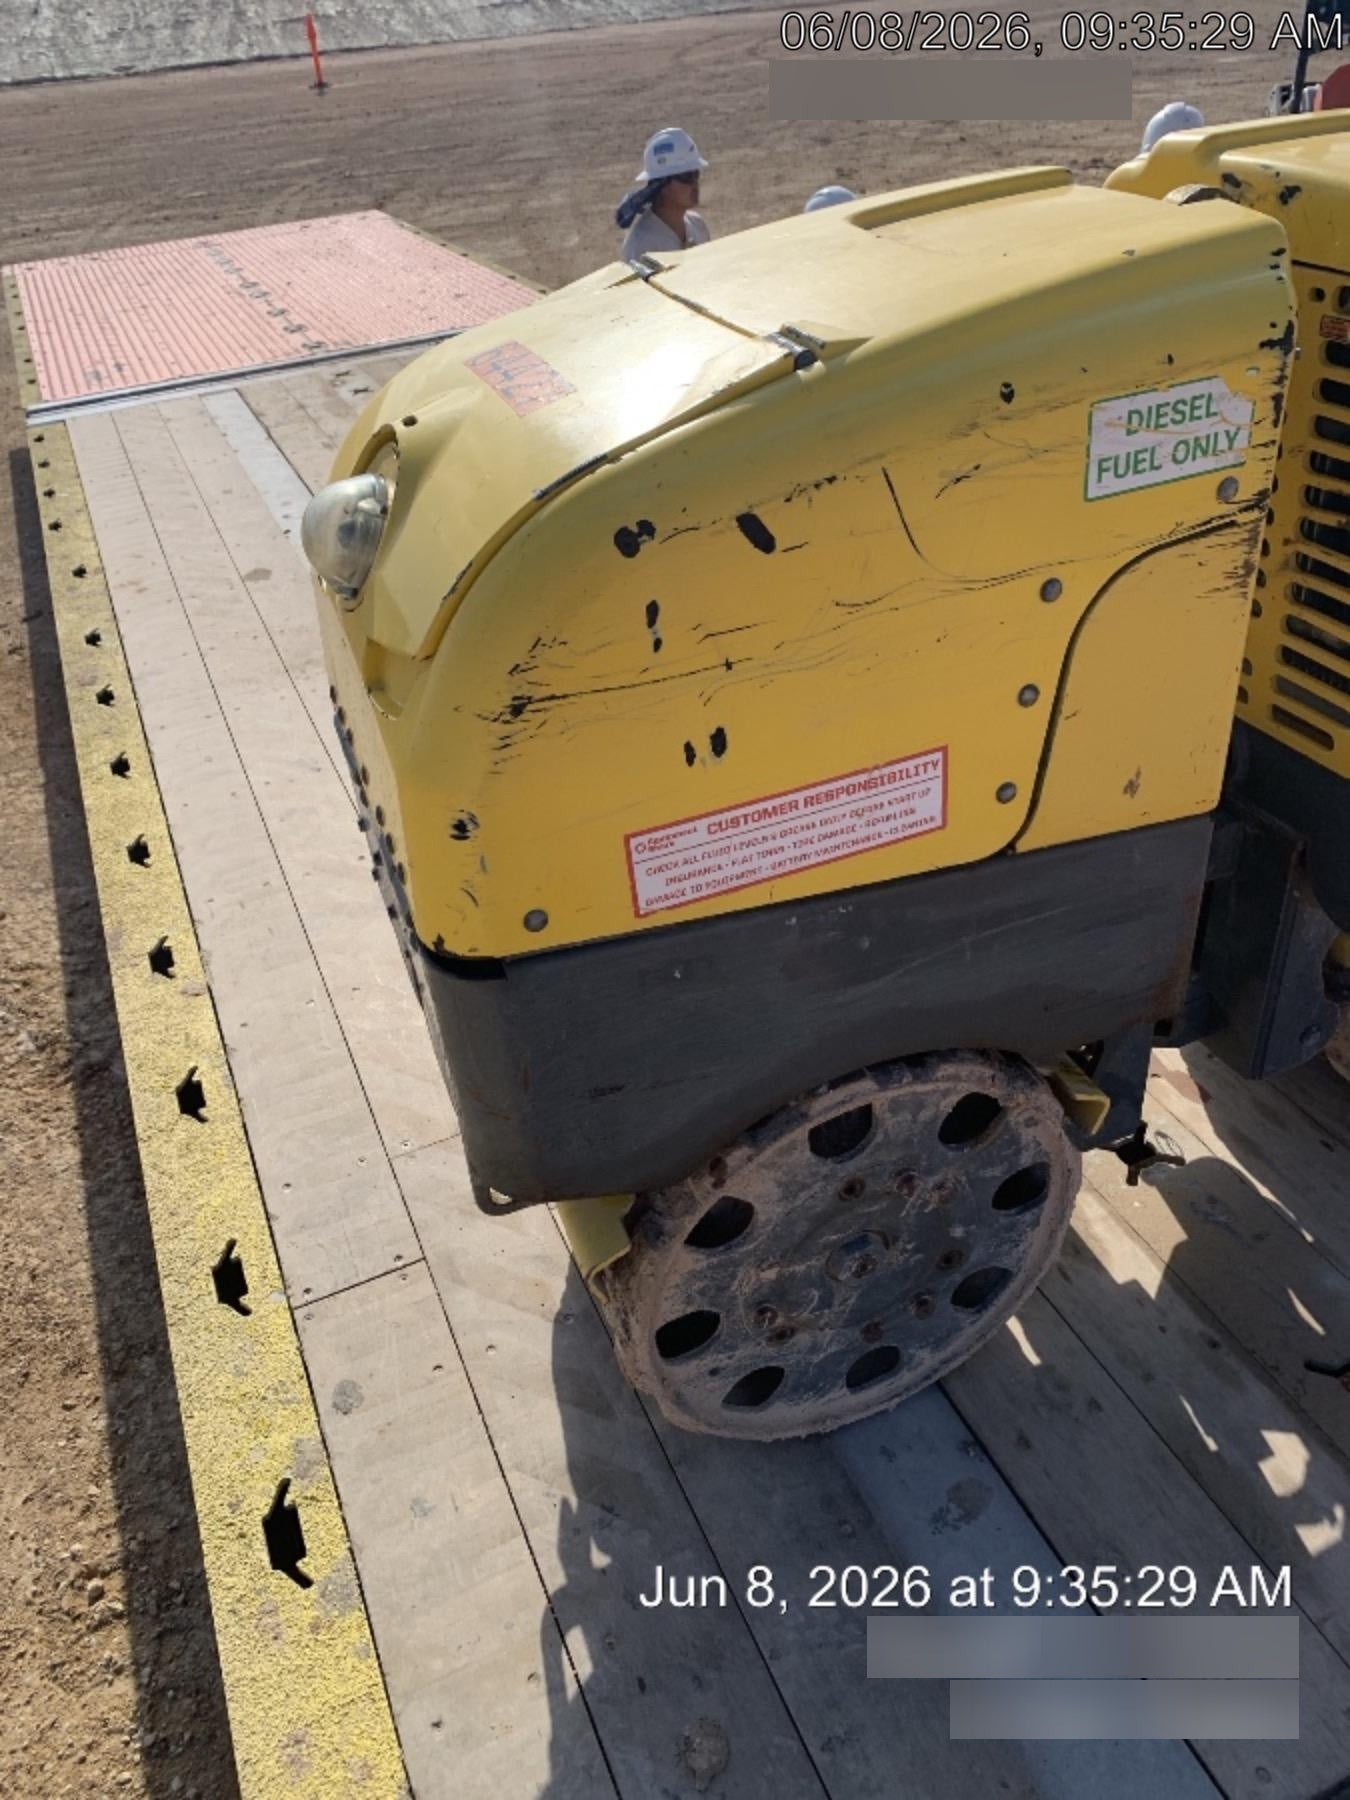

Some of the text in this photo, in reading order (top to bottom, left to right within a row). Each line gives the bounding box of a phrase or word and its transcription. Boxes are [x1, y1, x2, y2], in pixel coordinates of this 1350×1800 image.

[1126, 392, 1219, 436] DIESEL
[1097, 427, 1241, 484] FUEL ONLY
[707, 758, 940, 835] CUSTOMER RESPONSIBILITY
